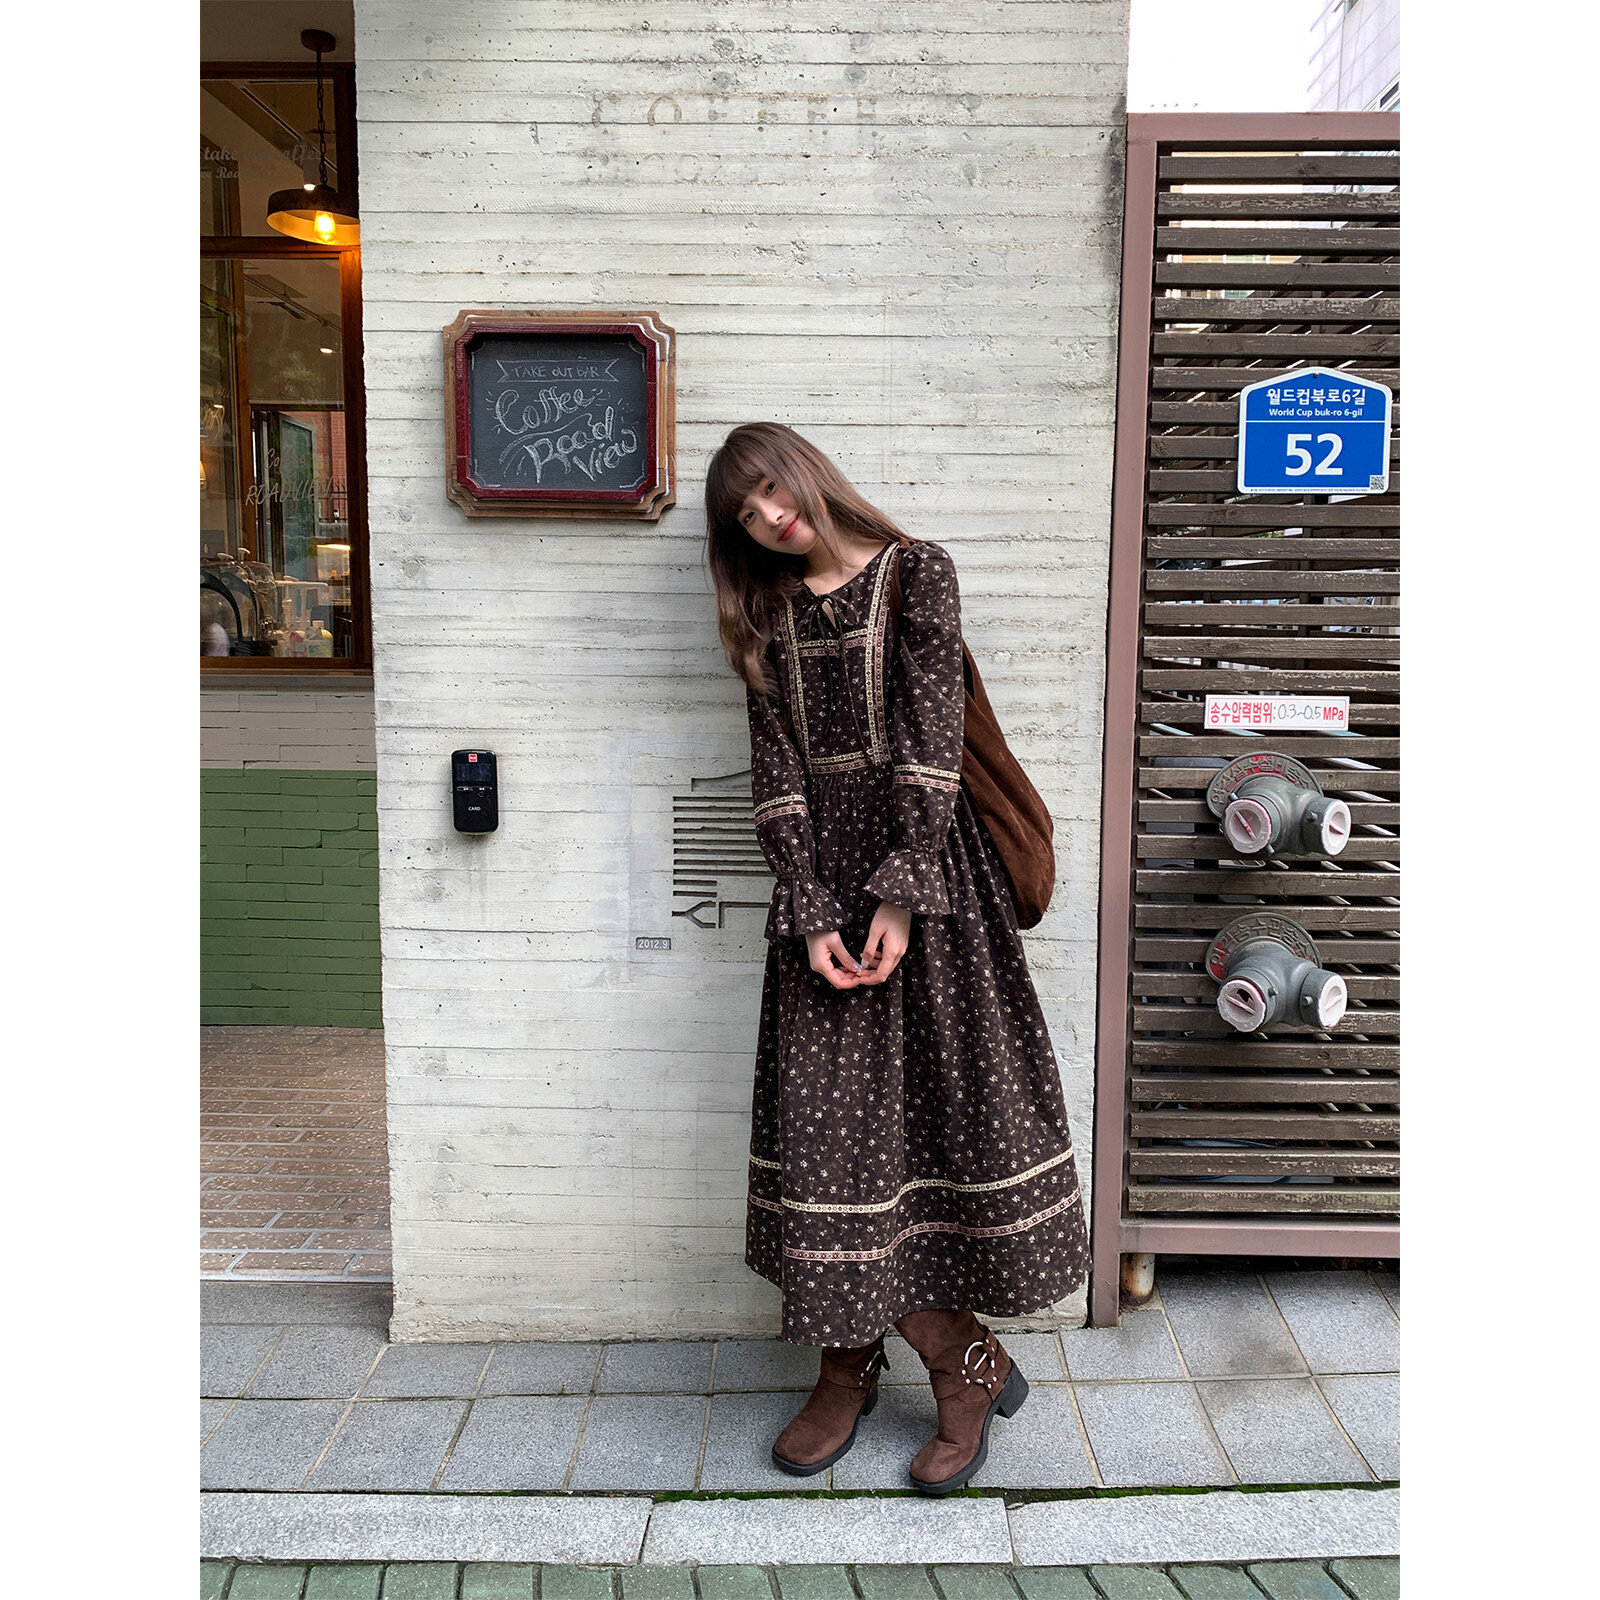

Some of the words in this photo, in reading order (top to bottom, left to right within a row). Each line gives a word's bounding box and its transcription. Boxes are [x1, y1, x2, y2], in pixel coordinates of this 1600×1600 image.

[204, 145, 239, 160] take
[276, 142, 321, 165] offee
[513, 366, 546, 378] TAKE
[552, 366, 574, 378] OUT
[576, 365, 601, 378] BAR
[1266, 388, 1366, 406] 월드컵북로6길
[495, 386, 598, 435] Coffee
[1268, 408, 1295, 417] World
[1296, 408, 1313, 418] Cup
[1314, 408, 1342, 417] buk-ro
[1344, 408, 1363, 418] 6-gil
[523, 405, 614, 483] Road
[1285, 432, 1344, 477] 52
[1210, 701, 1277, 724] 송수압력범위:
[1323, 706, 1344, 721] MPa
[638, 938, 668, 950] 2012.9
